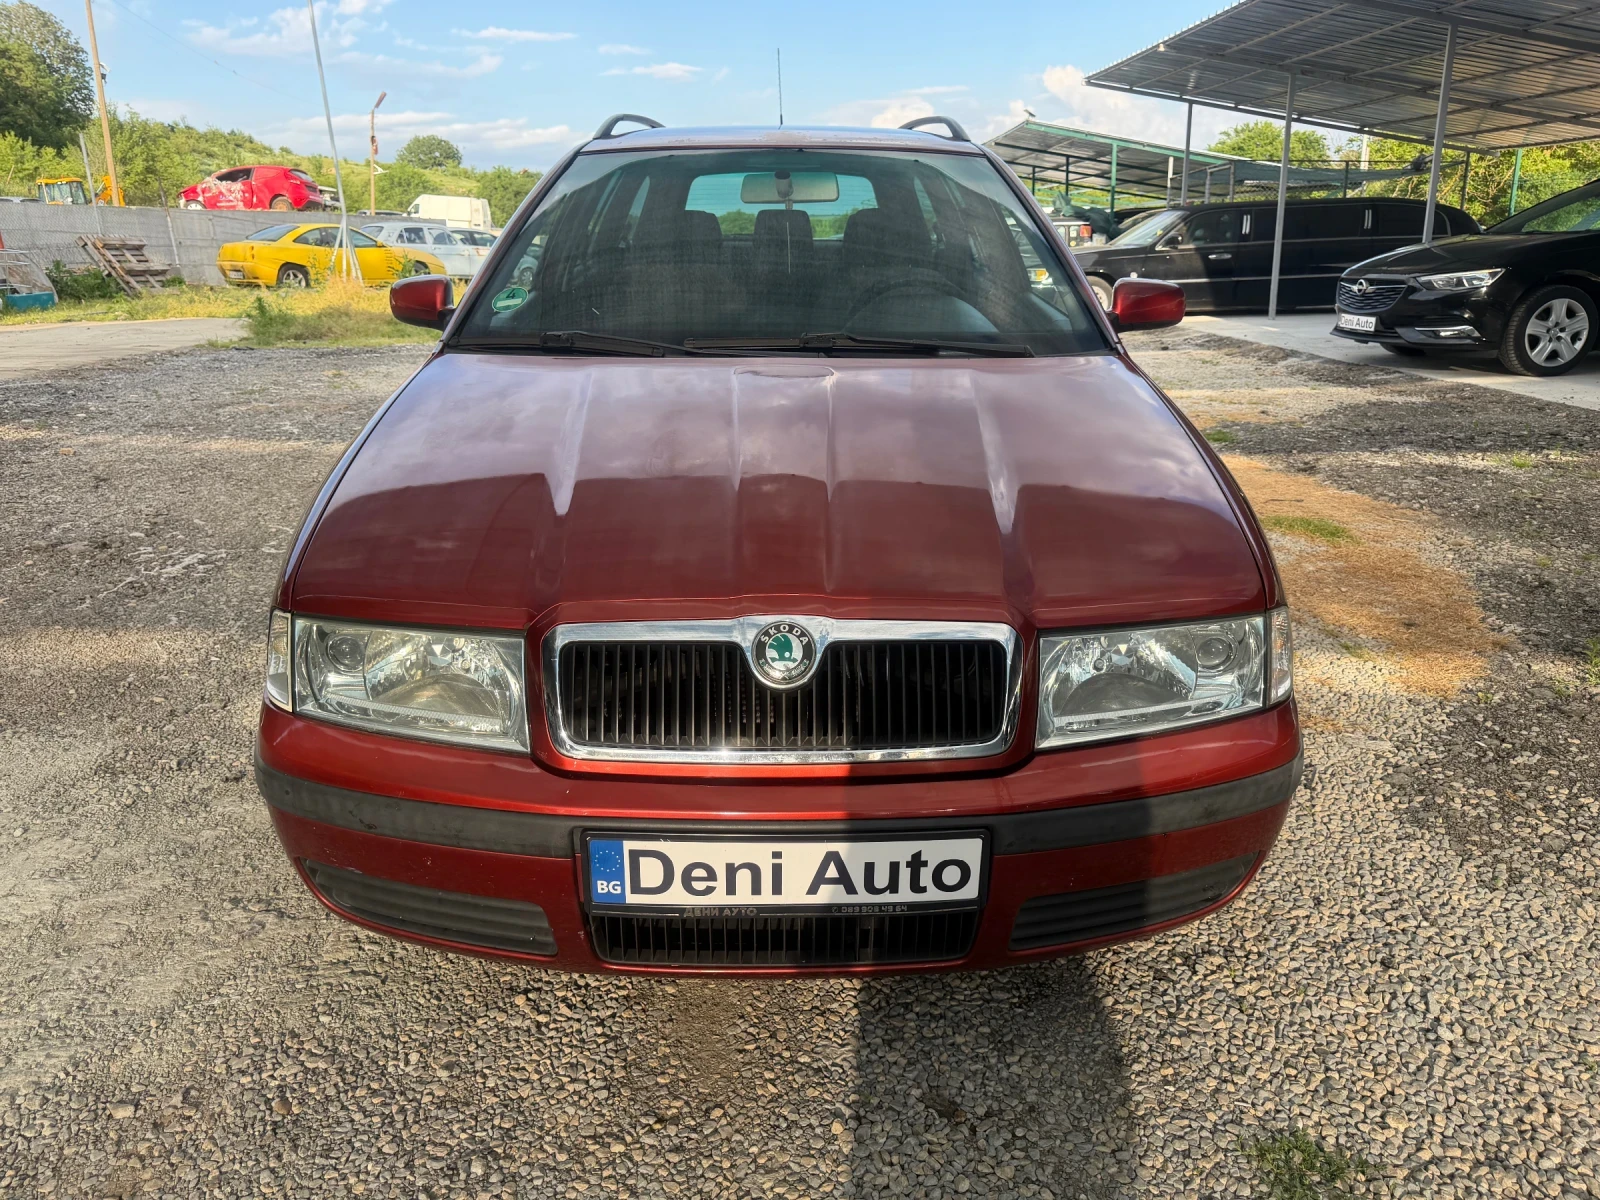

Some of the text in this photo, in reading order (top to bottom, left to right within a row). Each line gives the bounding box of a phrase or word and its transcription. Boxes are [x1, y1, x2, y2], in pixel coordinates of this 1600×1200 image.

[505, 288, 516, 299] 4
[1340, 316, 1373, 329] Deni Auto
[628, 848, 972, 896] Deni Auto
[596, 880, 622, 894] BG
